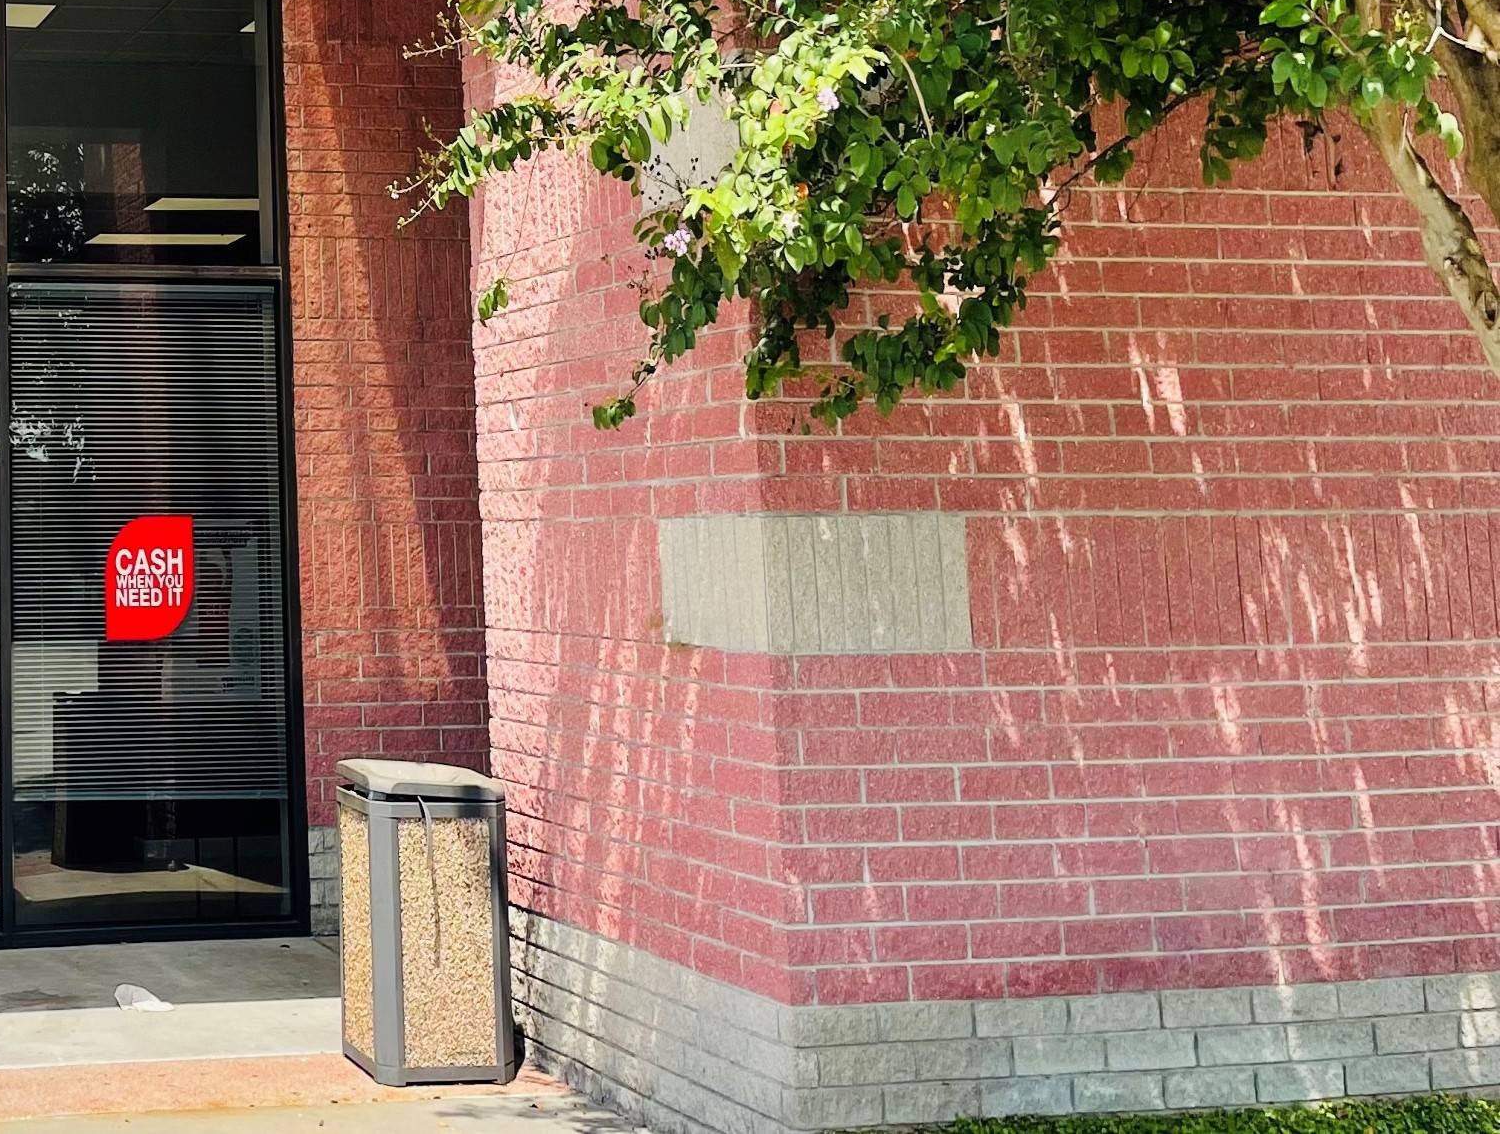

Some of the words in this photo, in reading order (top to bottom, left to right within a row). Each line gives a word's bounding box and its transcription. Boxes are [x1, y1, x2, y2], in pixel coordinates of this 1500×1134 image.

[115, 548, 183, 575] CASH
[116, 575, 153, 589] WHEN
[156, 574, 183, 587] YOU
[115, 588, 163, 607] NEED
[168, 588, 184, 606] IT
